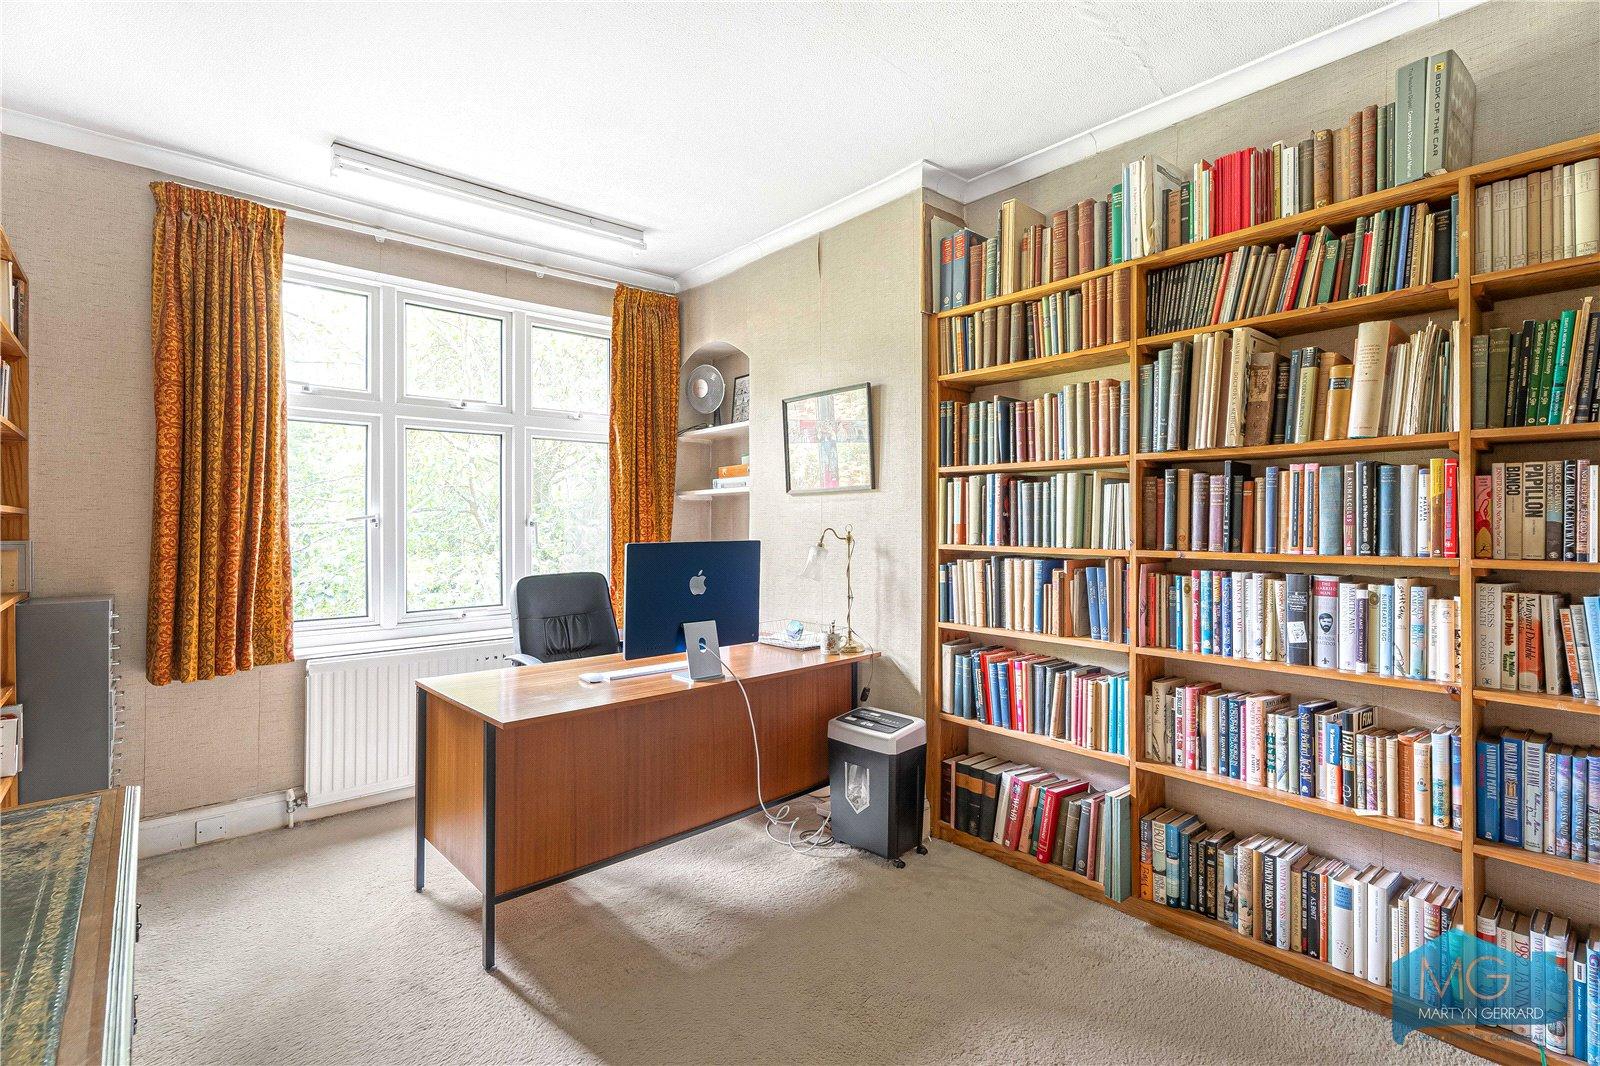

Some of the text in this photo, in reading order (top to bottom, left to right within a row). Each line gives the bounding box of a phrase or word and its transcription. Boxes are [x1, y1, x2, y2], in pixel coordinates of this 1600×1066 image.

[1435, 102, 1441, 114] OF
[1506, 466, 1521, 496] BANCO
[1524, 463, 1544, 518] PAPILLON
[1566, 464, 1576, 548] UTZ BRUCE CHATWIN
[1479, 586, 1487, 627] & HEALTH
[1487, 587, 1495, 628] SICKNESS
[1503, 595, 1515, 647] Margaret Drabble
[1524, 597, 1536, 661] Margaret Drabble
[1562, 614, 1570, 626] NELL
[1563, 627, 1572, 642] DUNN
[1479, 635, 1487, 671] DOUGLAS
[1567, 644, 1575, 655] THE
[1361, 713, 1373, 726] FIXX
[1301, 734, 1311, 756] Bedford
[1342, 735, 1353, 751] FIXX
[1527, 747, 1540, 788] RONALD FRAME
[1487, 778, 1497, 800] PEOPLE
[1010, 799, 1020, 822] WEARY
[1154, 828, 1165, 851] BOYD
[1264, 856, 1274, 910] ANTHONY BURGESS
